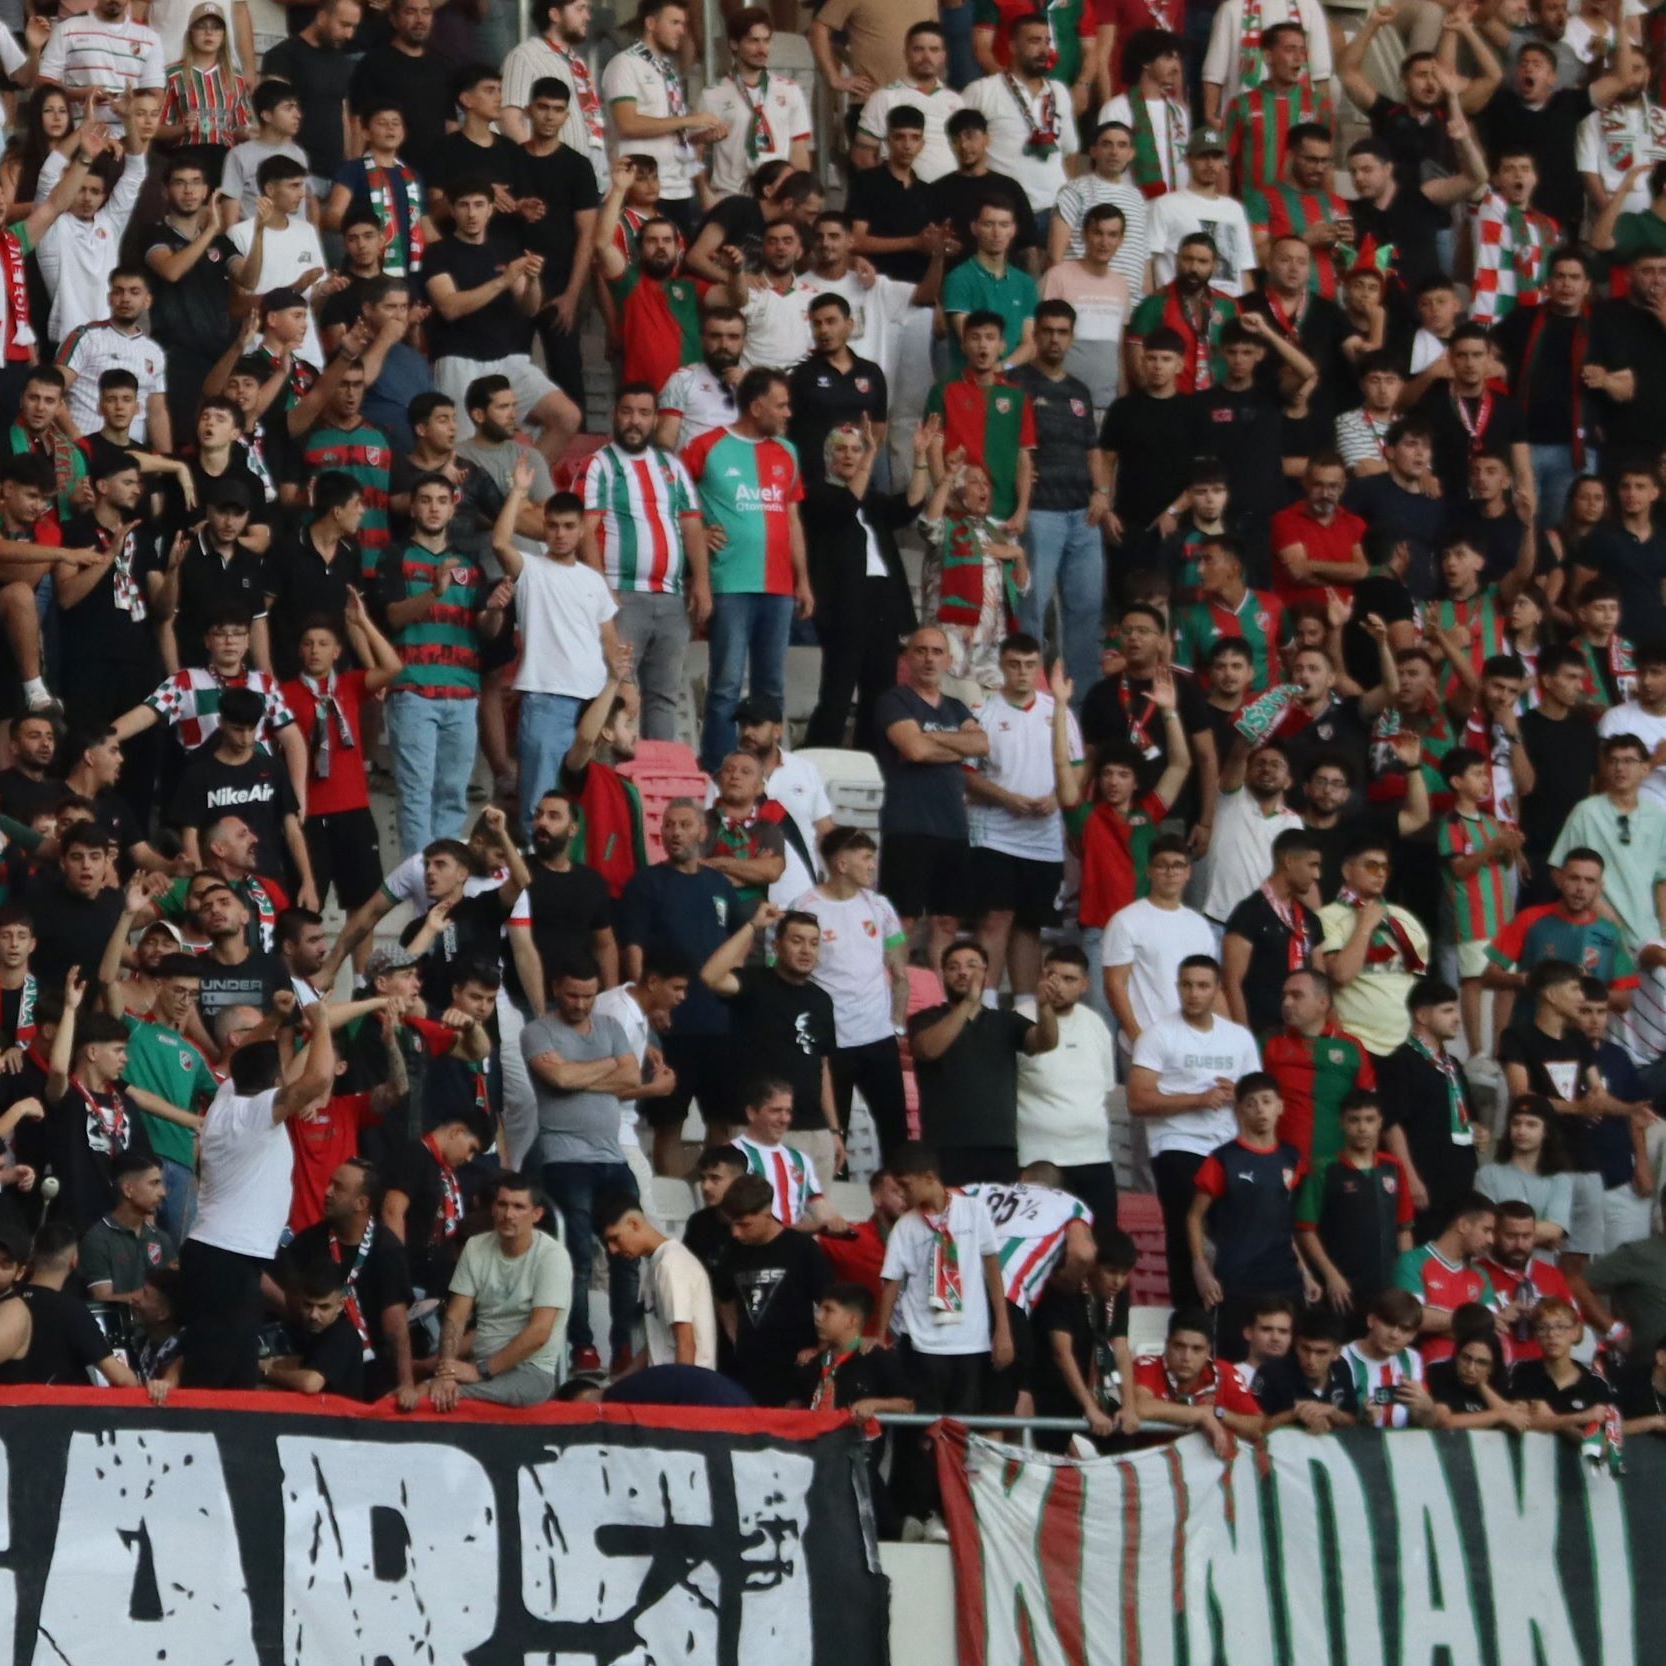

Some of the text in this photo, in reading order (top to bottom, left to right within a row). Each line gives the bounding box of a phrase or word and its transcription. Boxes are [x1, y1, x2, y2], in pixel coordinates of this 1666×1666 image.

[735, 484, 785, 504] Avek
[201, 979, 264, 991] UNDER
[1183, 1053, 1235, 1072] GUESS
